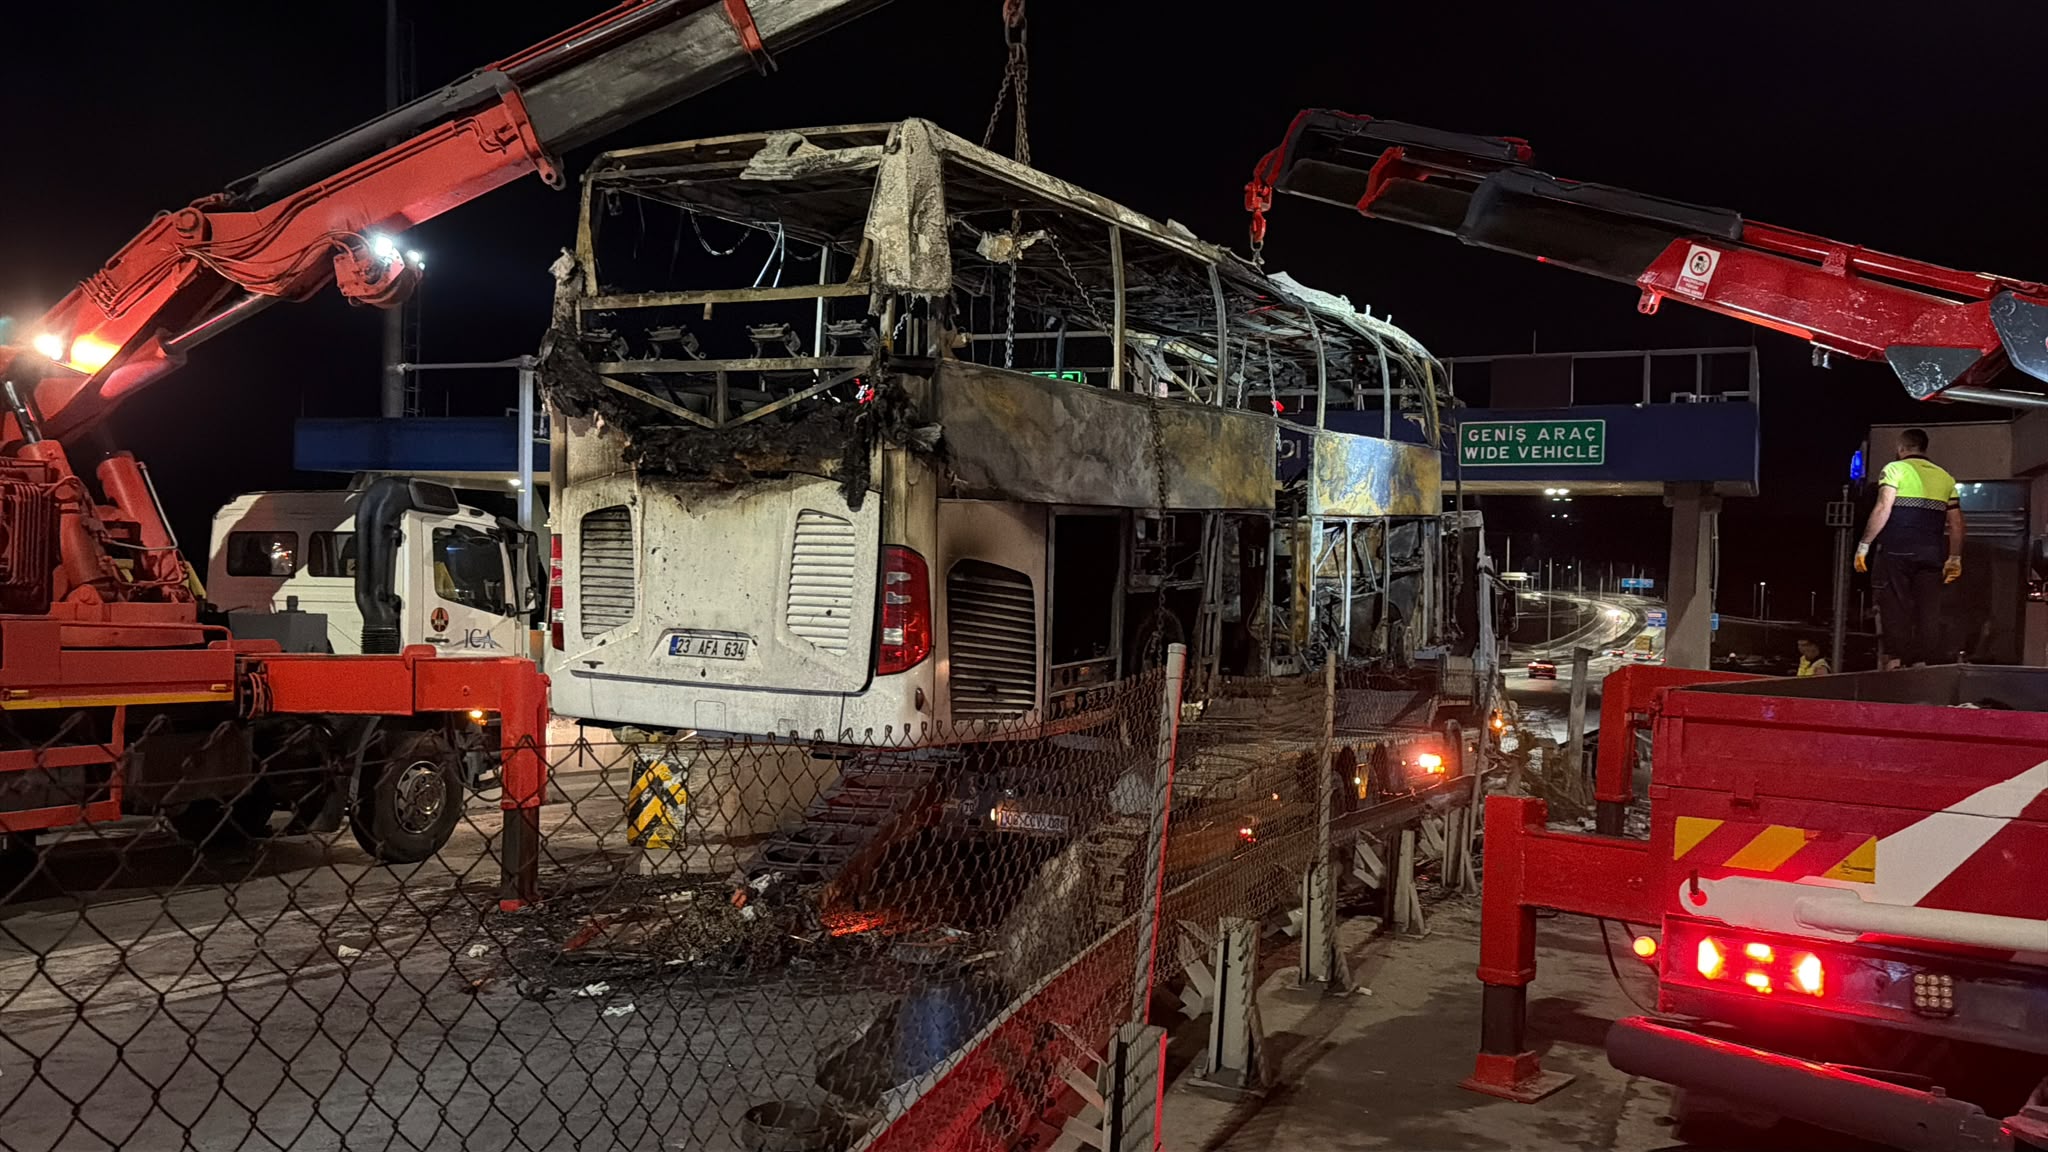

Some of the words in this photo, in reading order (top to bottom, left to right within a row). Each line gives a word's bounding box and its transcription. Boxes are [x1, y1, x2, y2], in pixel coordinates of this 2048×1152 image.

[1468, 425, 1527, 443] GENİŞ
[1537, 427, 1596, 442] ARAÇ
[1464, 446, 1510, 459] WIDE
[1518, 445, 1600, 459] VEHICLE
[676, 639, 691, 653] 23
[698, 640, 718, 655] AFA
[723, 642, 744, 657] 634
